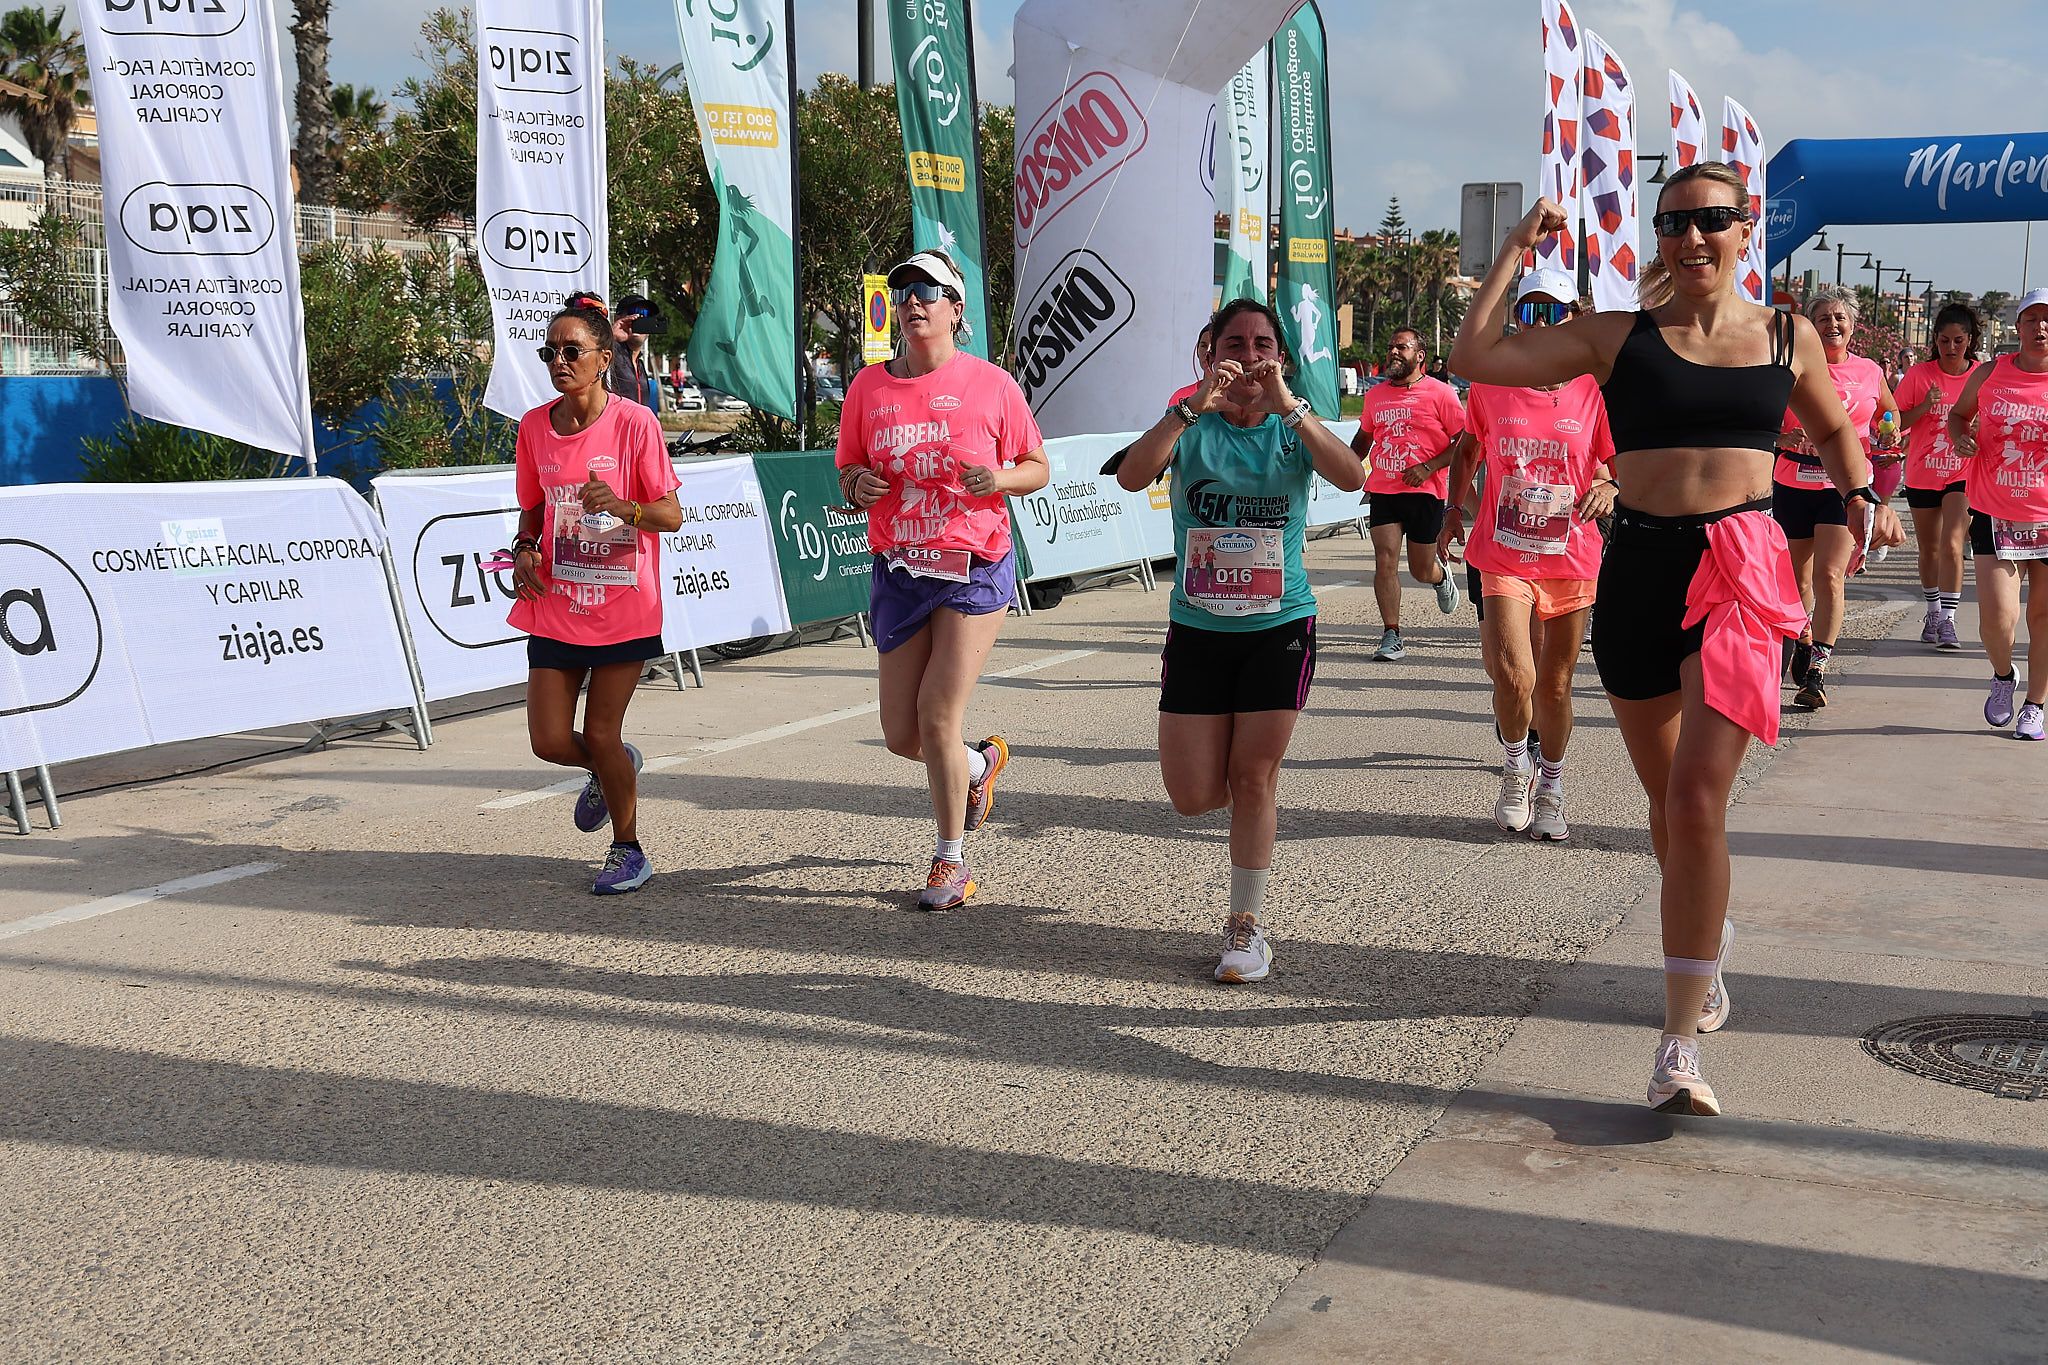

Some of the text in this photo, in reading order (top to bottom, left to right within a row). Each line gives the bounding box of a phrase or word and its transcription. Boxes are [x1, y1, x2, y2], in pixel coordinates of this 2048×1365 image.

[1766, 209, 1792, 226] rlene
[869, 403, 901, 419] OYSHO
[1498, 417, 1528, 425] OYSHO
[538, 464, 560, 473] YSHO
[1925, 458, 1961, 470] MUJER
[1996, 469, 2045, 488] MUJER
[1236, 494, 1289, 505] NOCTURNA
[680, 502, 757, 524] CIAL, CORPORAL
[1236, 504, 1290, 516] VALENCIA
[1519, 513, 1548, 527] 016
[2014, 530, 2038, 540] 016
[580, 541, 611, 555] 016
[664, 534, 716, 553] Y CAPILAR
[1216, 541, 1253, 549] ASTURIANA
[92, 542, 214, 573] COSMÉTICA
[216, 543, 285, 567] FACIAL,
[908, 549, 941, 560] 016
[1520, 553, 1539, 563] 2026
[561, 569, 585, 578] OYSHO
[1216, 568, 1252, 583] 016
[673, 566, 730, 599] ziaja.es
[205, 578, 303, 605] Y CAPILAR
[219, 621, 324, 665] ziaja.es
